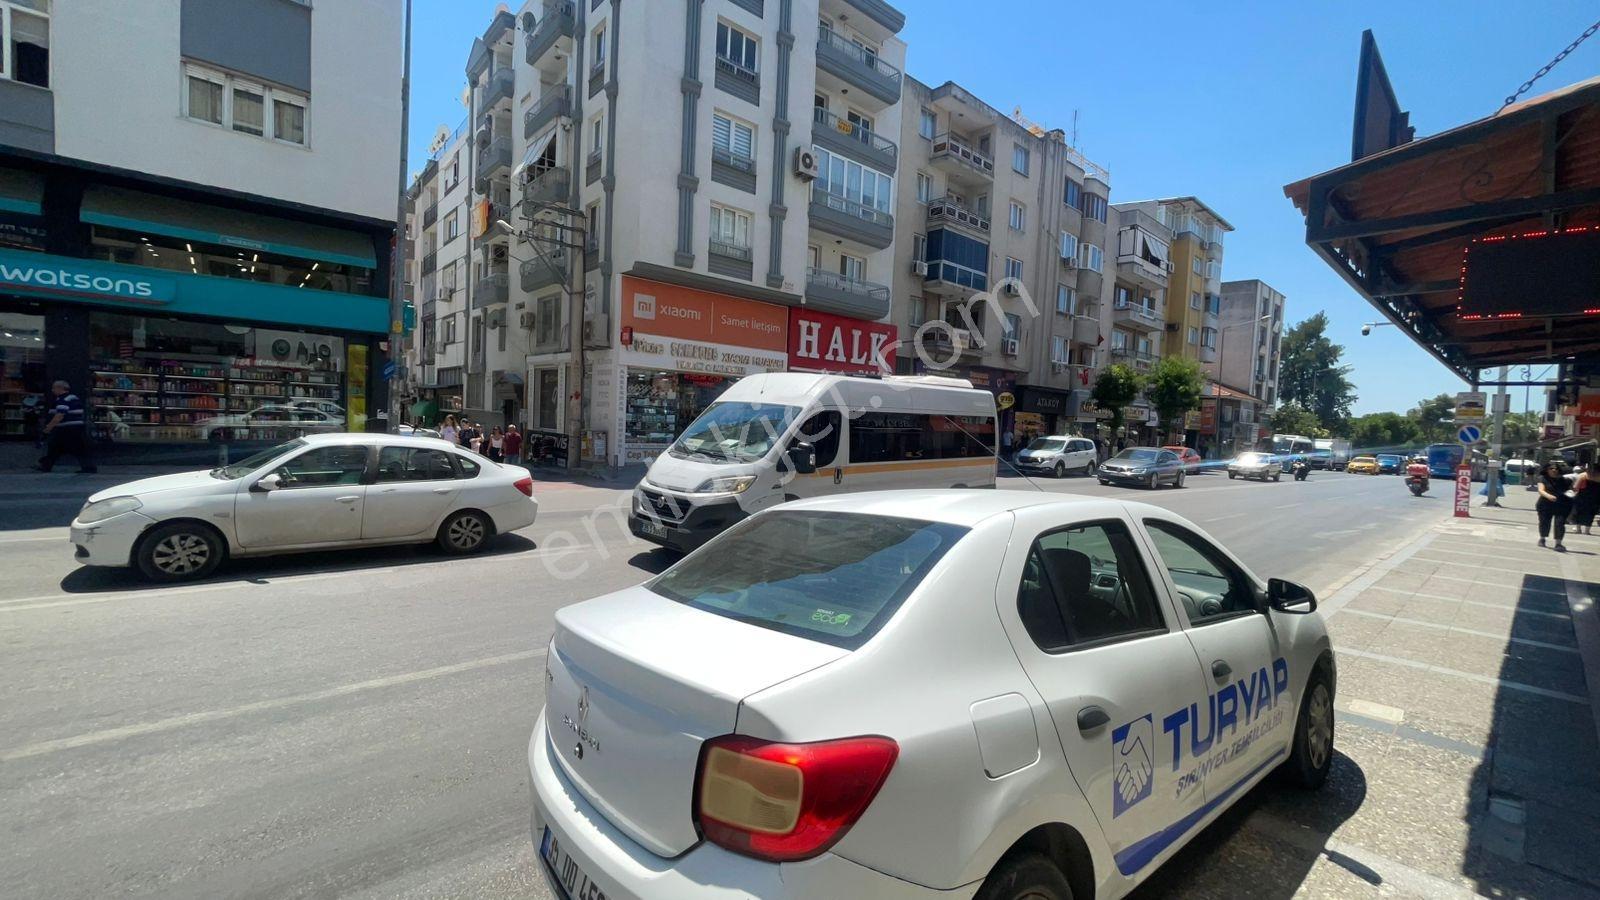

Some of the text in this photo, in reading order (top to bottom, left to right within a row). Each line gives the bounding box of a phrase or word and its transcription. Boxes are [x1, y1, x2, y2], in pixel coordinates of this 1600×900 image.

[0, 264, 152, 296] watsons
[721, 314, 781, 334] Samet İletişim
[797, 320, 893, 374] HALK
[626, 450, 641, 460] Cep
[1456, 469, 1471, 512] ECZANE
[1163, 656, 1288, 772] TURYAP
